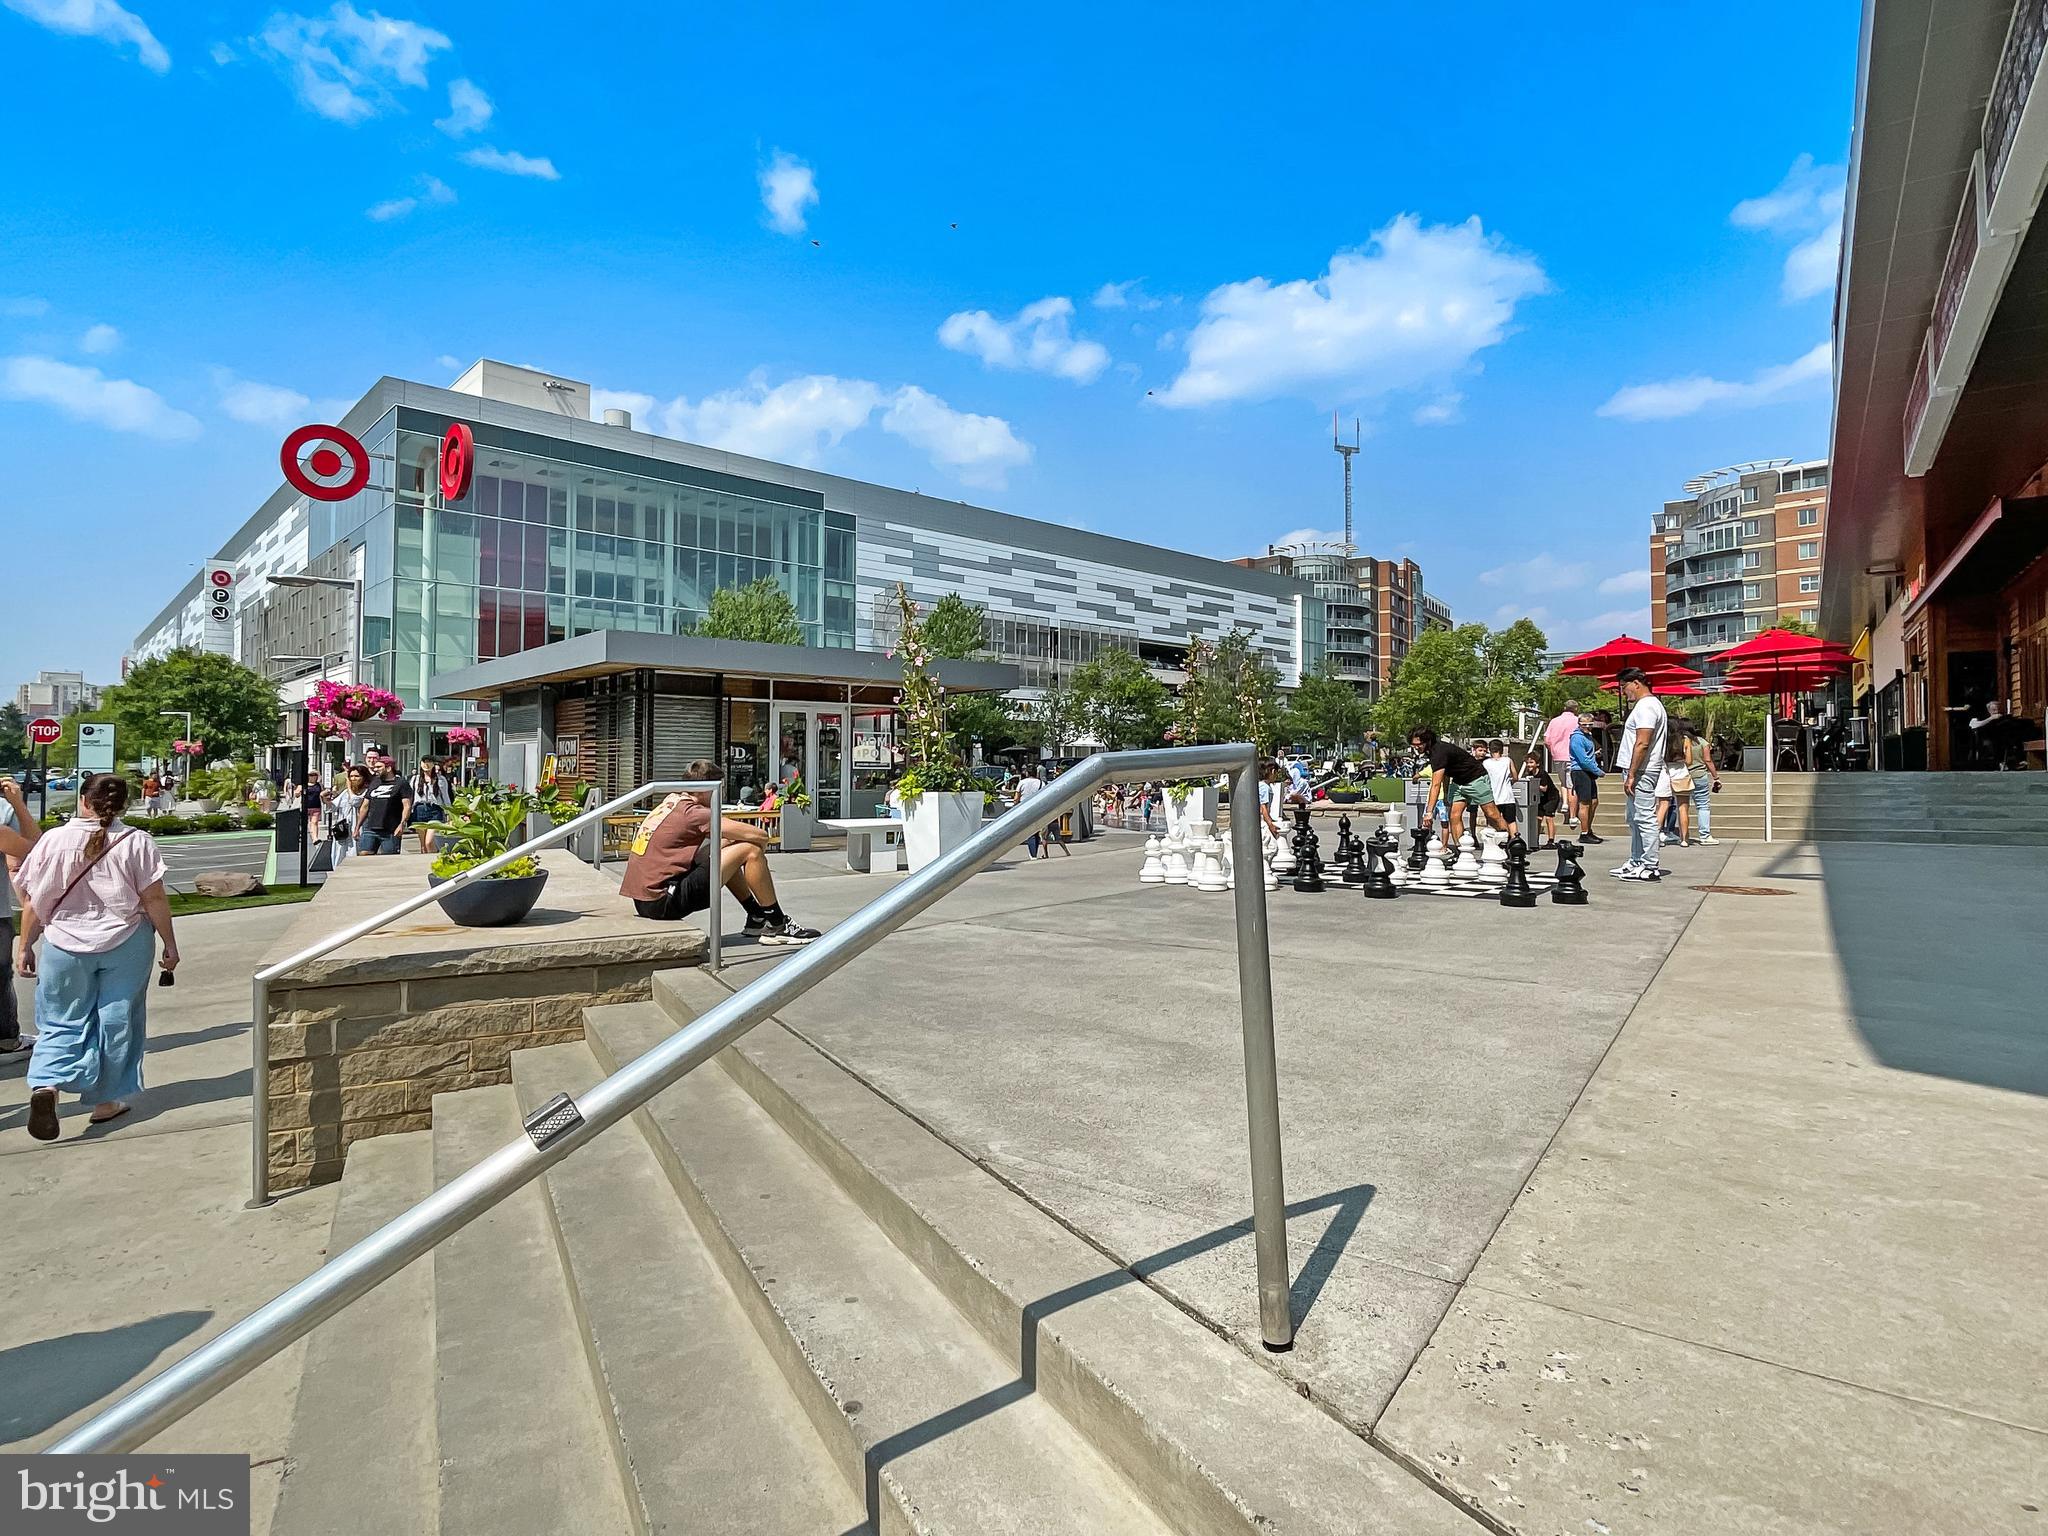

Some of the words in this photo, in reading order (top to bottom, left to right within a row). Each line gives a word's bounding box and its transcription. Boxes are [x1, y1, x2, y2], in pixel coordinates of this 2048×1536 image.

[216, 591, 226, 600] P
[30, 725, 60, 737] STOP
[857, 736, 888, 747] MOM
[559, 740, 577, 756] MOM
